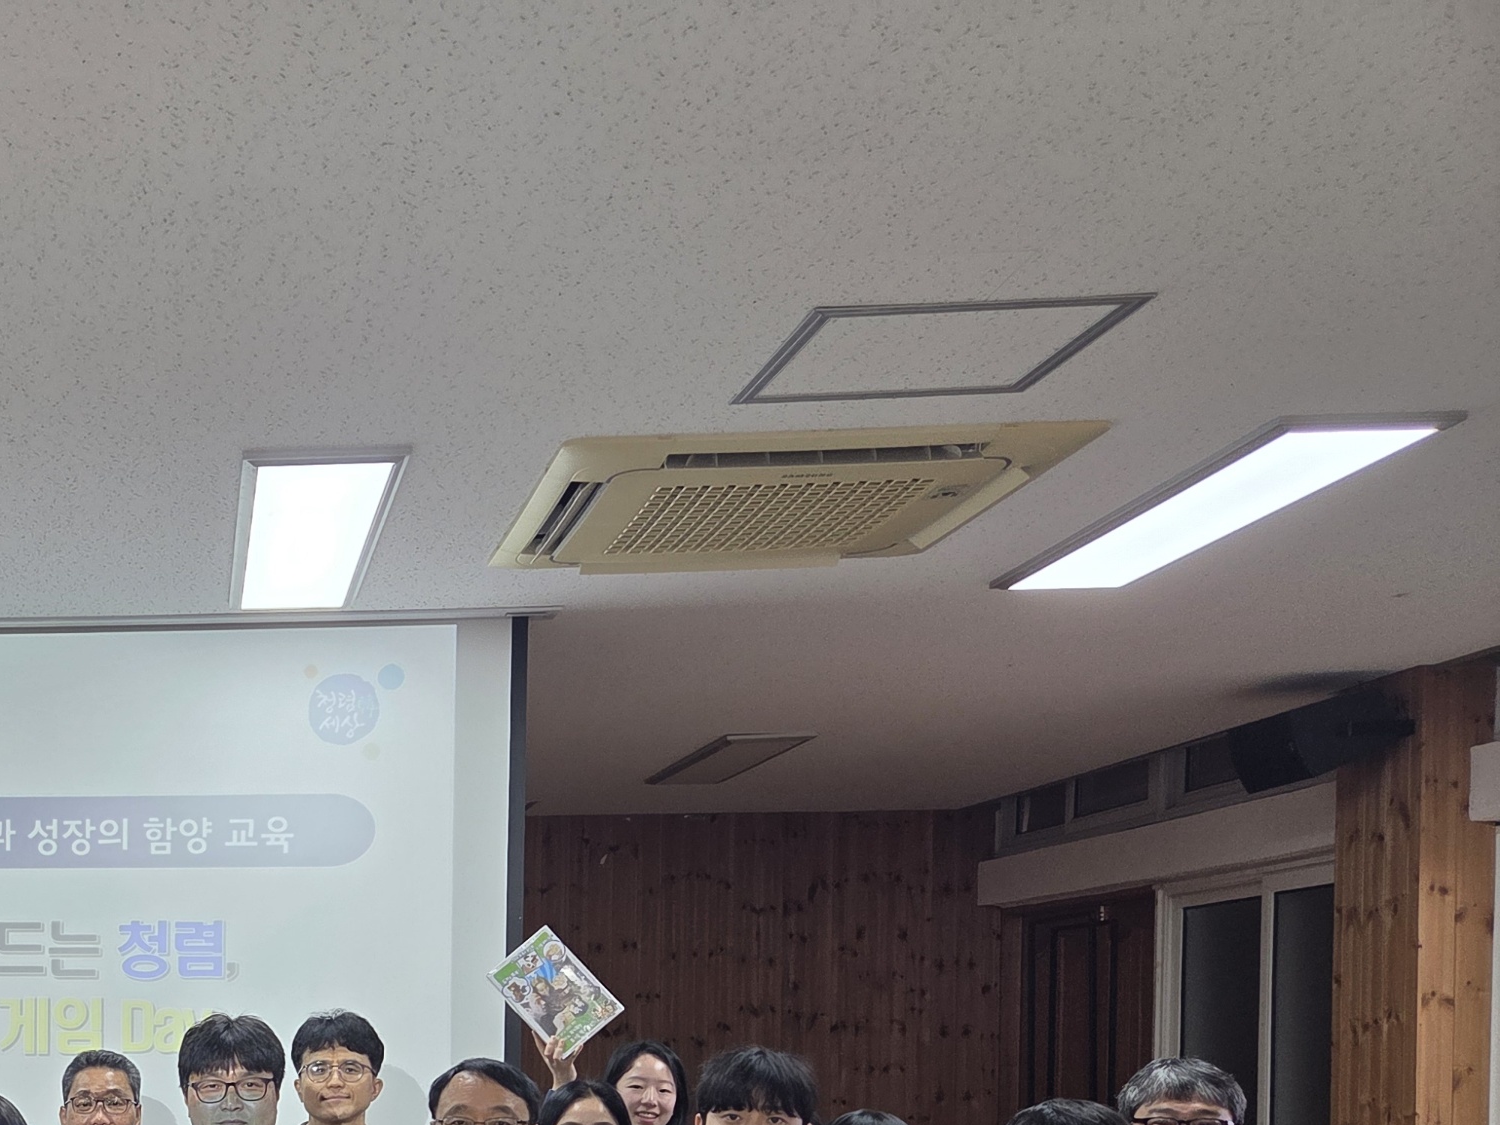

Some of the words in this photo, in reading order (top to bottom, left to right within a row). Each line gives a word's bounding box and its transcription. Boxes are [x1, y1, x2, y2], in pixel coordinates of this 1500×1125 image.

[319, 713, 365, 738] 세상
[27, 817, 129, 852] 성장의
[144, 816, 211, 852] 함양
[226, 815, 294, 852] 교육
[118, 920, 240, 981] 청렴,
[0, 997, 104, 1055] 게임
